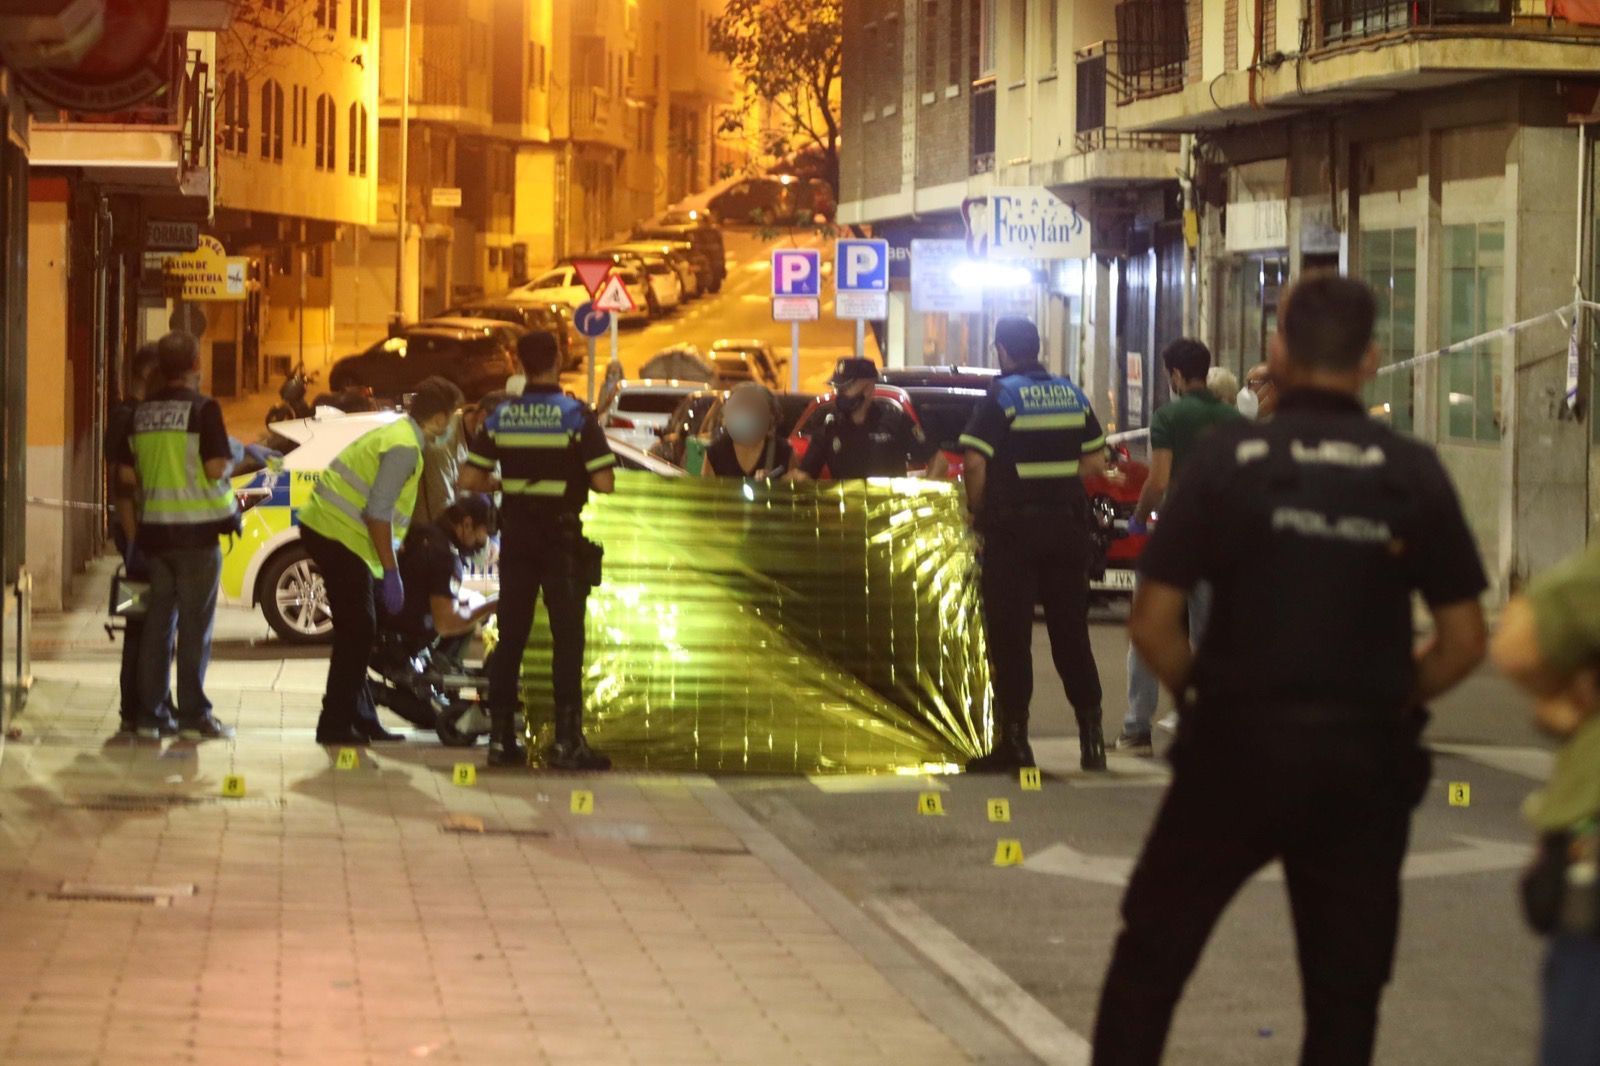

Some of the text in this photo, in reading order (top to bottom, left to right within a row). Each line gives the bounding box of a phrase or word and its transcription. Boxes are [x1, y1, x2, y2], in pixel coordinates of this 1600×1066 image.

[993, 196, 1070, 251] Froylán
[781, 254, 811, 293] P
[846, 245, 878, 288] P
